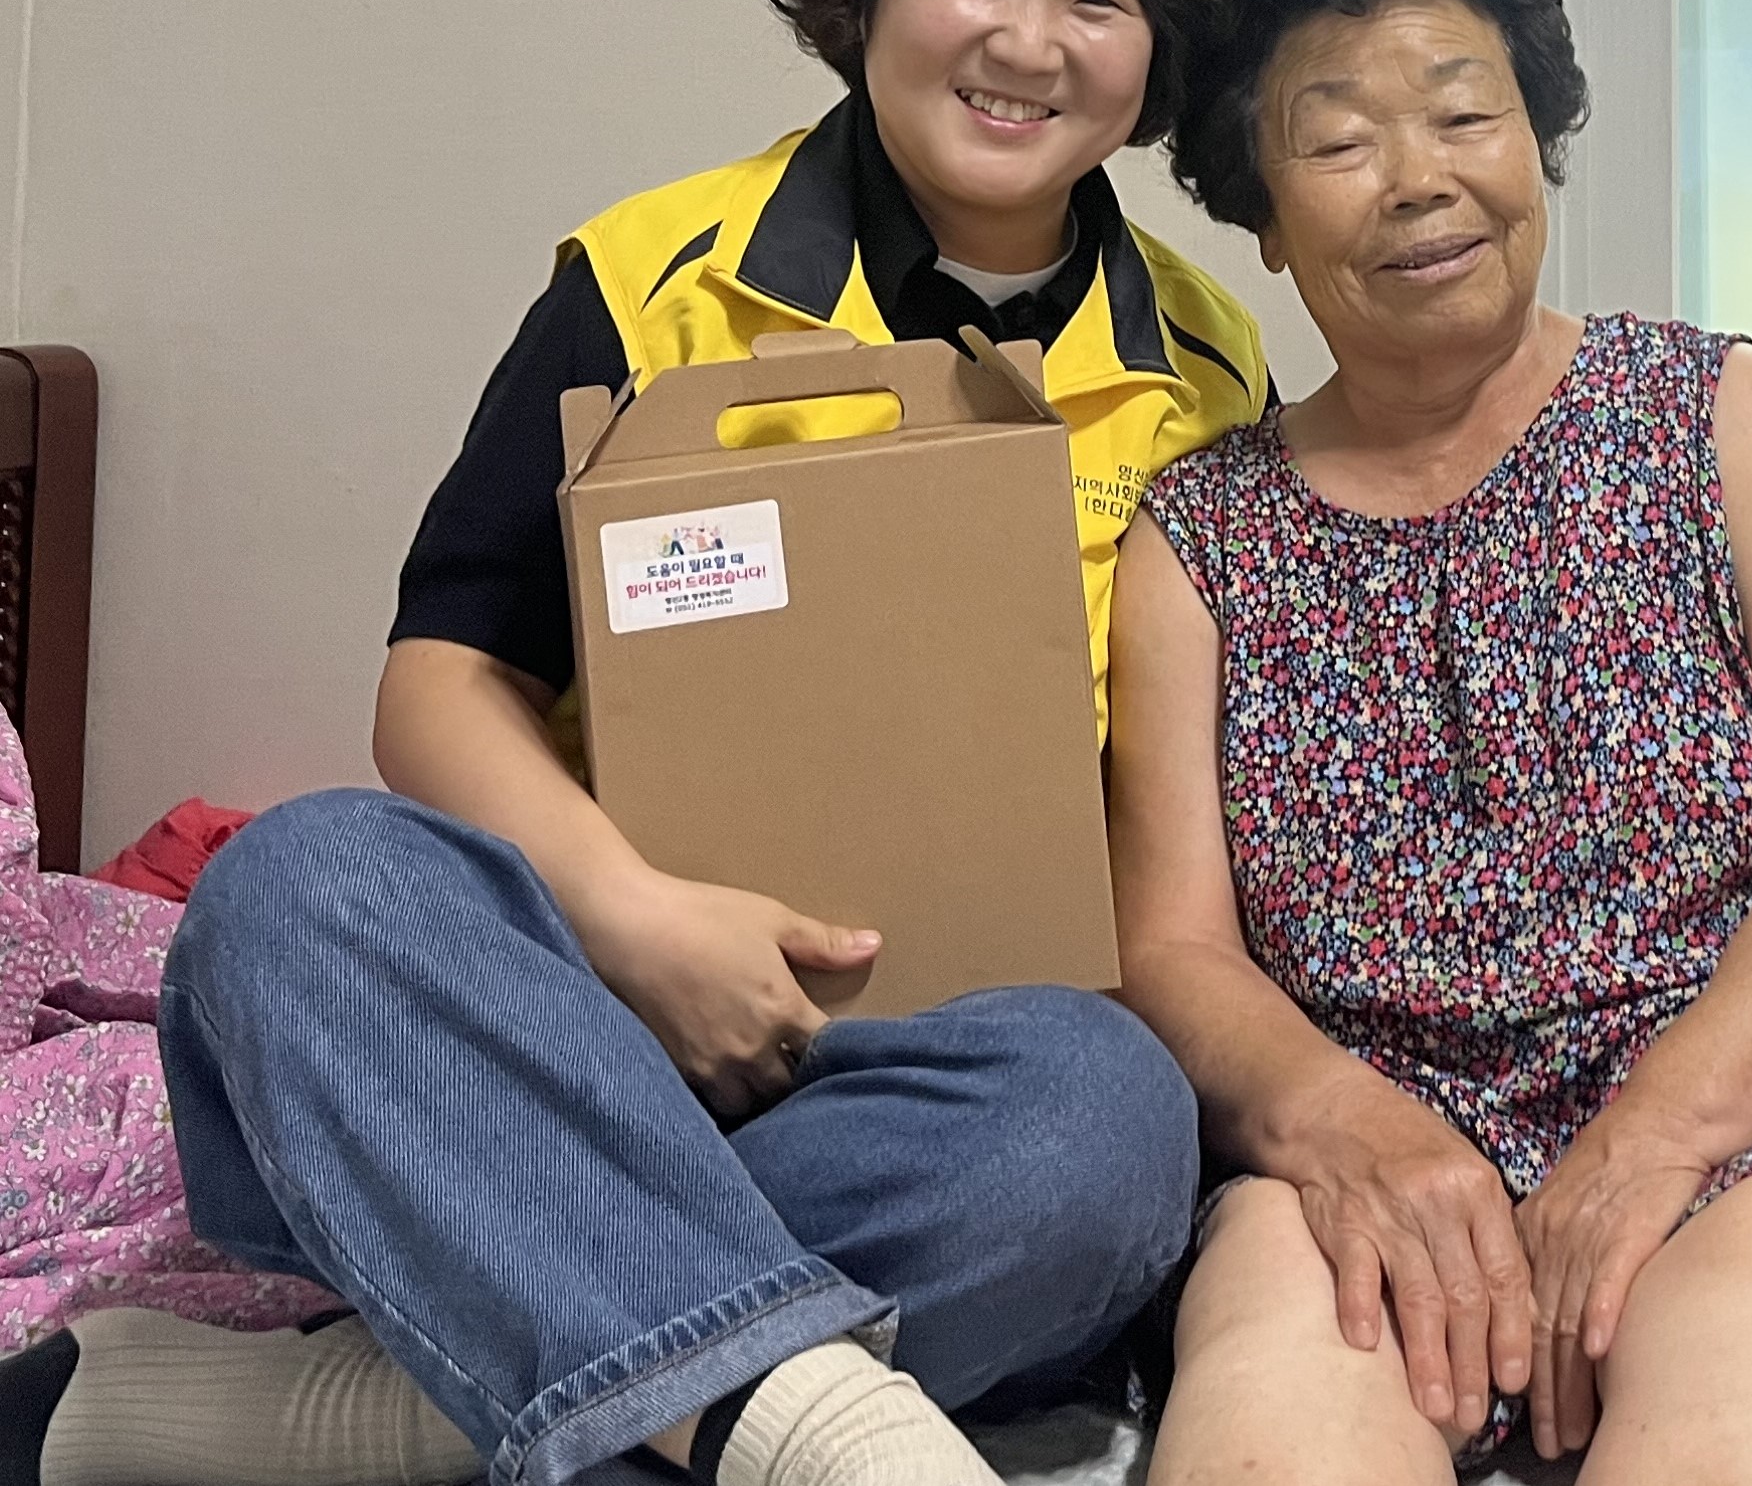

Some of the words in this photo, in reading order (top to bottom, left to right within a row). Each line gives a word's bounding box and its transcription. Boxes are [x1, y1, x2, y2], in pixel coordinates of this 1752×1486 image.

[646, 560, 685, 578] 도움이
[688, 555, 726, 573] 필요할
[730, 552, 745, 565] 때
[625, 580, 652, 599] 힘이
[655, 577, 682, 594] 되어
[685, 565, 767, 589] 드리겠습니다!
